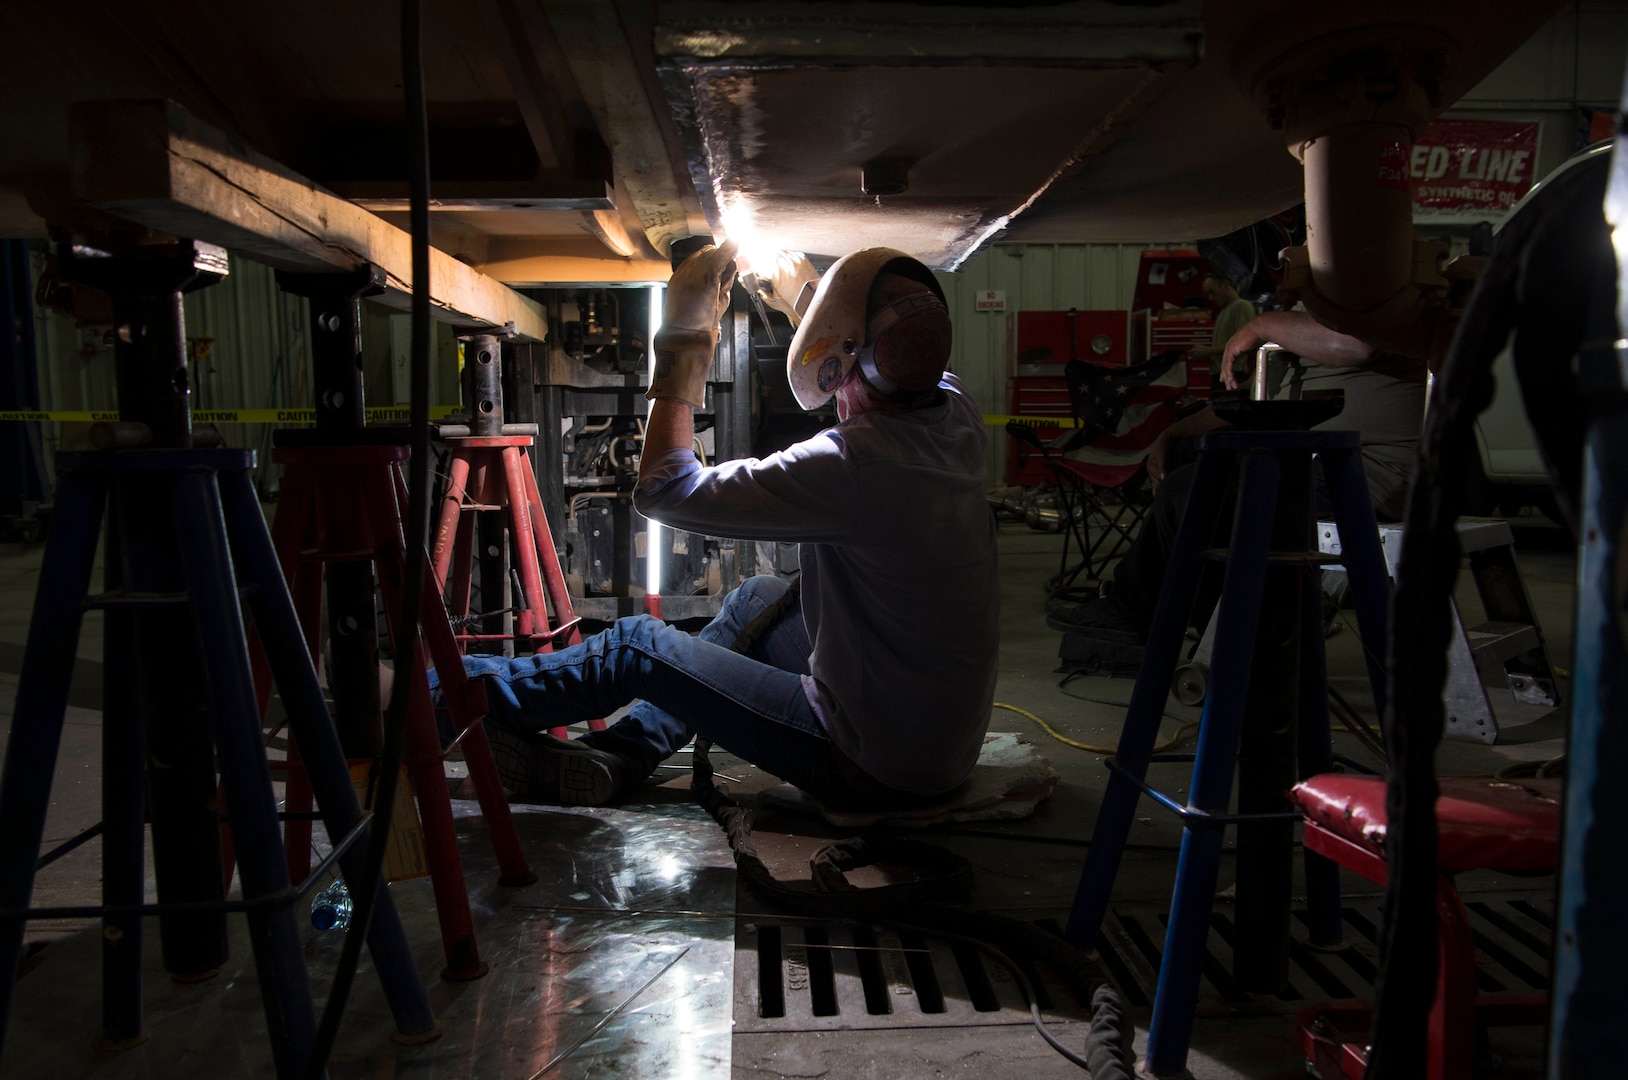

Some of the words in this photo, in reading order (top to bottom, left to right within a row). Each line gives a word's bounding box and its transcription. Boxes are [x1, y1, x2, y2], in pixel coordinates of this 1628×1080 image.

[1410, 145, 1450, 179] ED
[1459, 148, 1530, 184] LINE
[1418, 186, 1495, 202] SYNTHETIC
[1498, 190, 1518, 205] OIL
[0, 412, 49, 421] AUTION
[193, 412, 238, 421] AUTION
[277, 411, 317, 421] CAUTI
